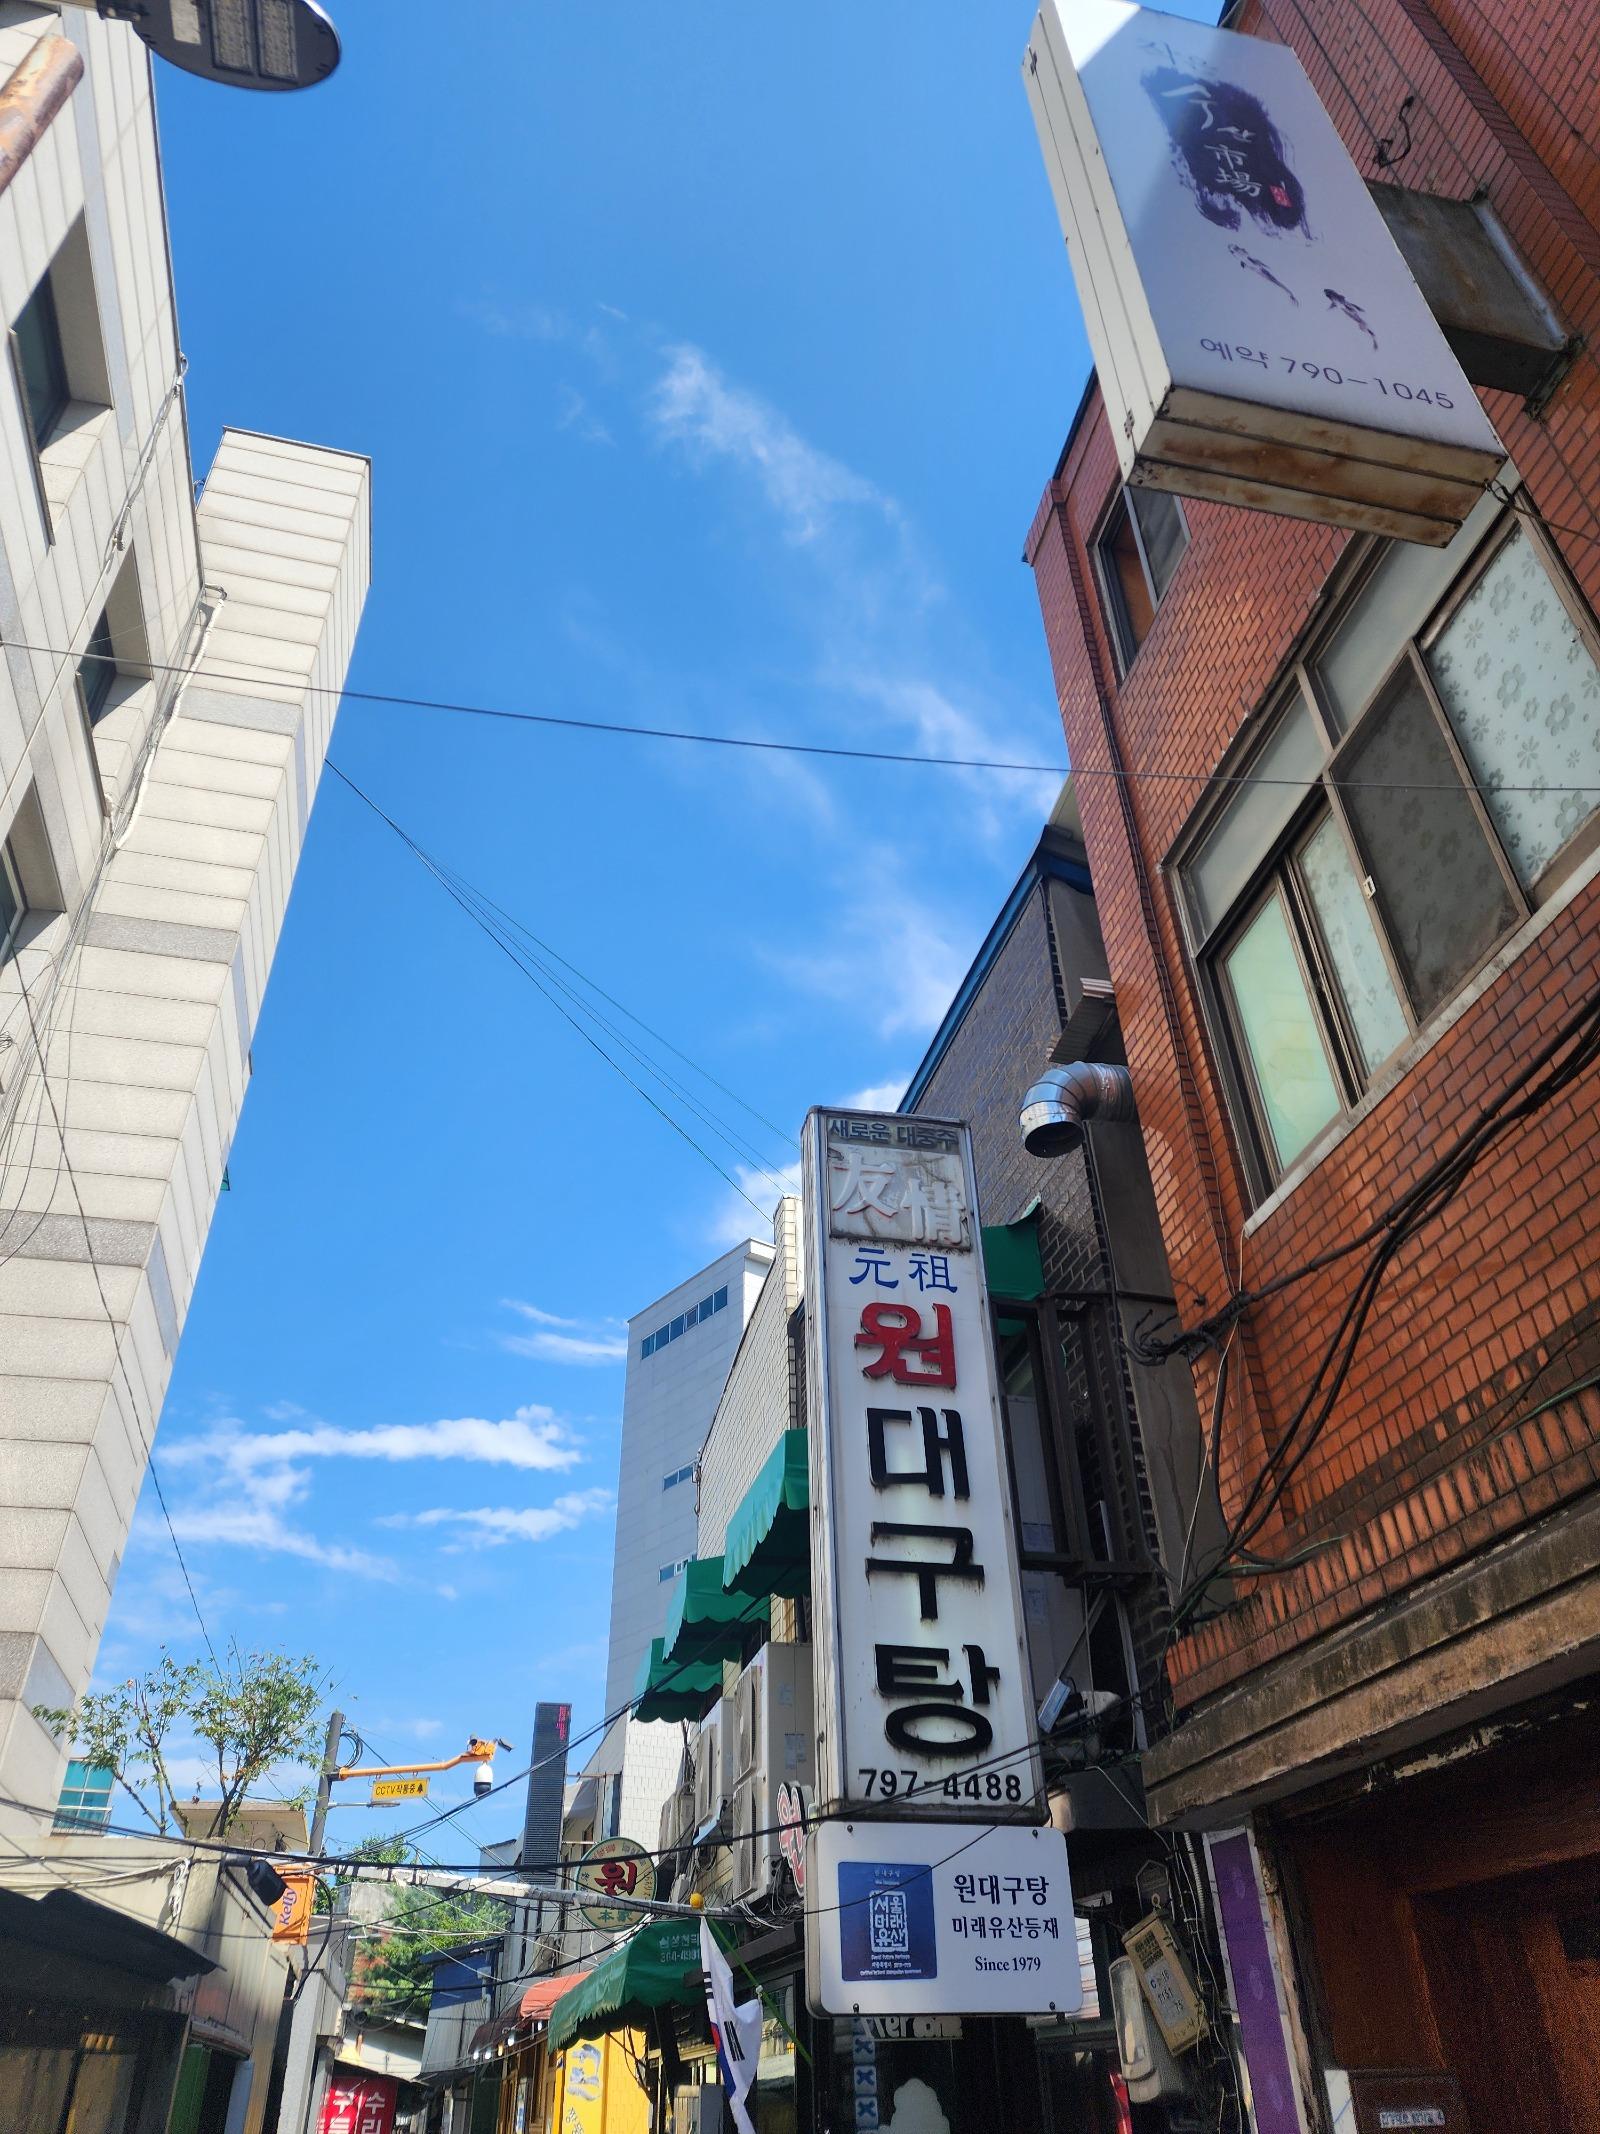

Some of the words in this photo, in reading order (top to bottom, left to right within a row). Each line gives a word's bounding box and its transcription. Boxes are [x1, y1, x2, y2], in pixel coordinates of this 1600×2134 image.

[1200, 339, 1269, 369] 예약
[1280, 356, 1454, 409] 790-1045
[829, 1119, 892, 1142] 새로운
[849, 1247, 958, 1293] 元祖
[854, 1302, 1000, 1757] 원대구탕
[858, 1768, 1022, 1803] 797-4488
[953, 1874, 1050, 1906] 원대구탕
[280, 1888, 298, 1925] Kelly
[874, 1896, 903, 1914] 서울
[874, 1913, 904, 1929] 미래
[951, 1916, 1059, 1940] 미래유산등재
[874, 1928, 906, 1947] 유산
[974, 1956, 1010, 1972] Since
[1012, 1956, 1042, 1972] 1979
